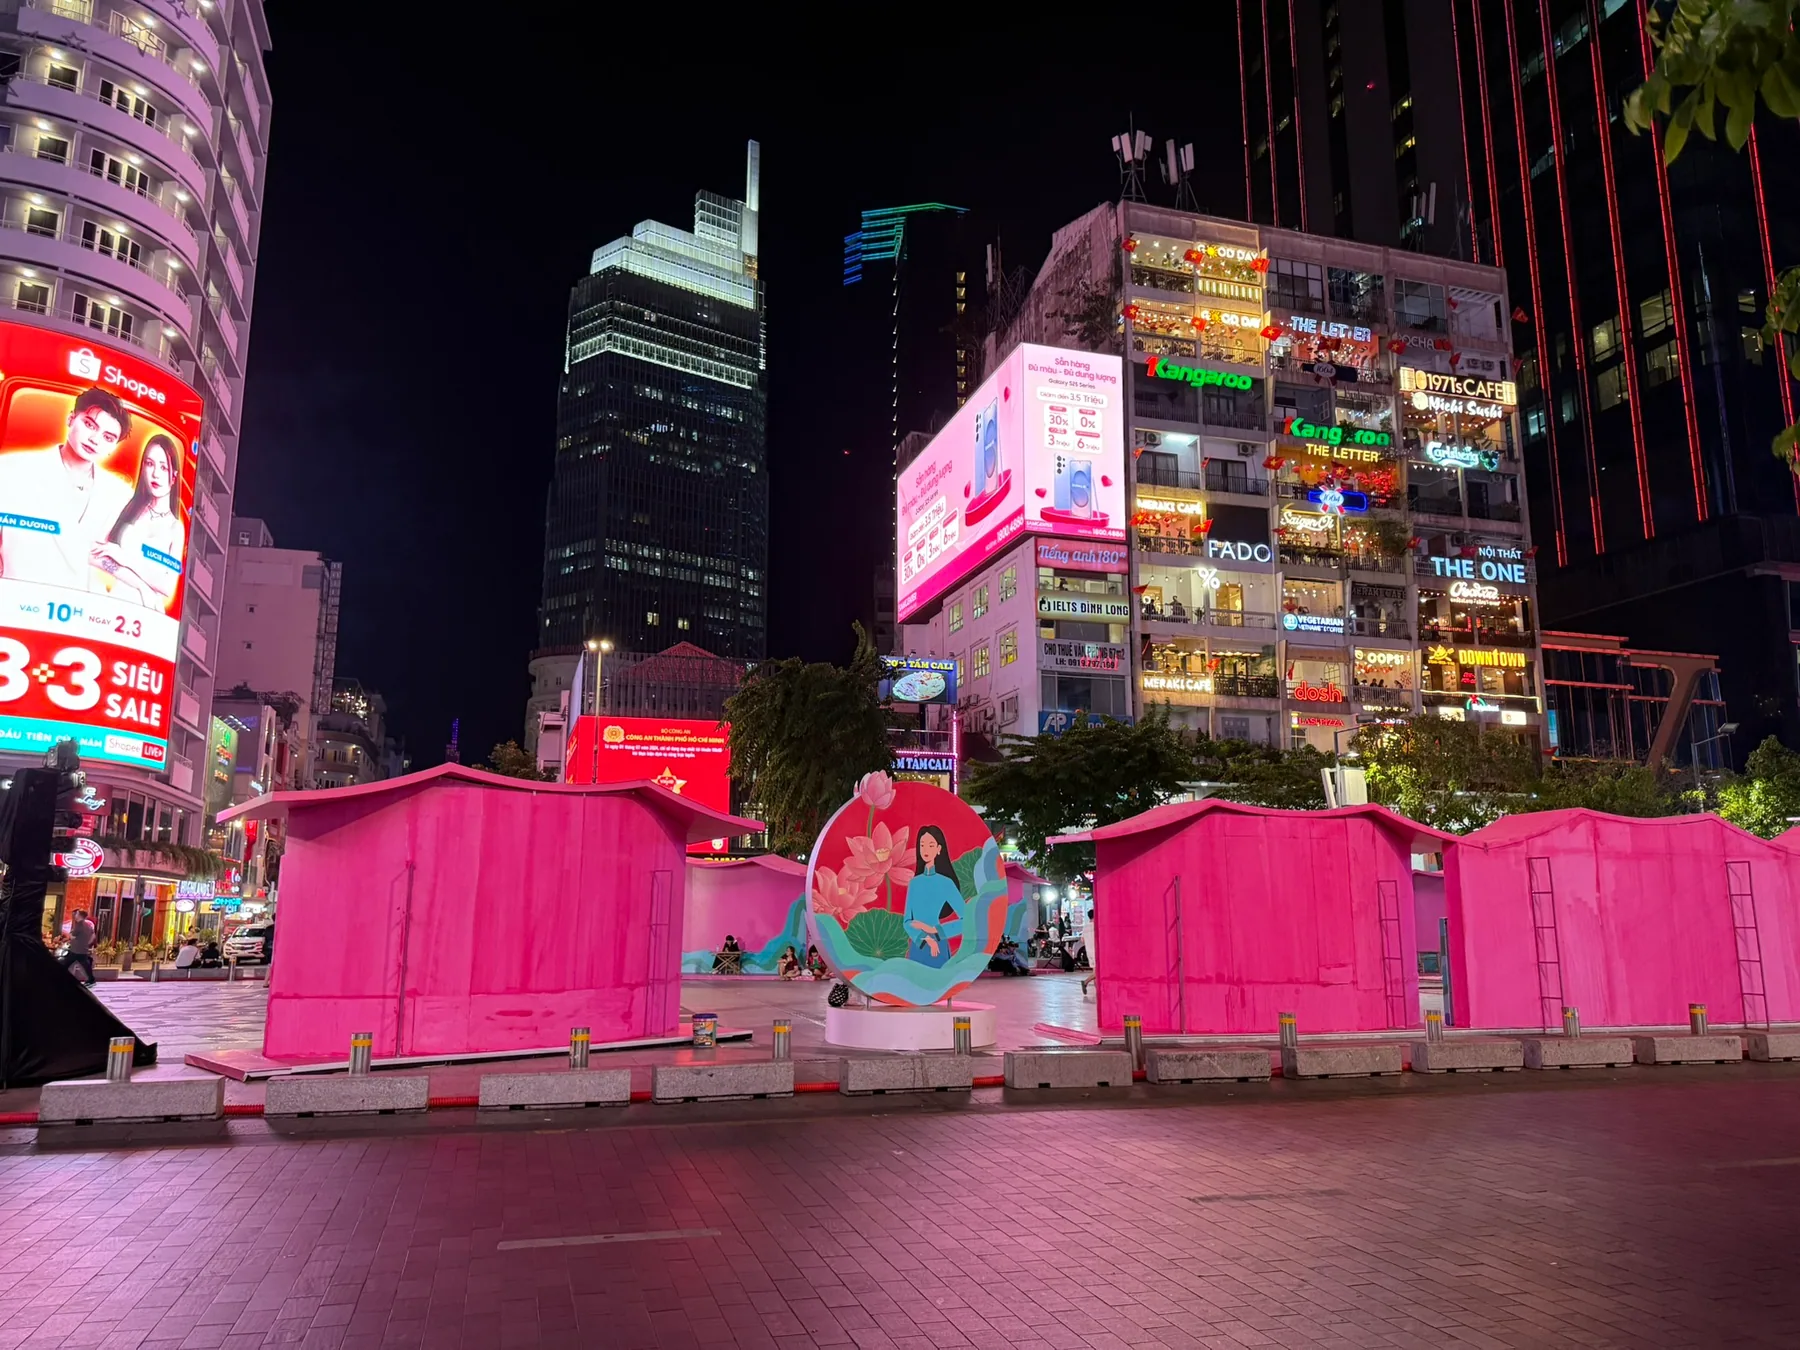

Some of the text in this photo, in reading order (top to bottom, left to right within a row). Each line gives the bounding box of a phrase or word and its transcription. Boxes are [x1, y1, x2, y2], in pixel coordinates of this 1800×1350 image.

[1236, 249, 1258, 261] DAY
[1291, 316, 1317, 333] THE
[1145, 355, 1252, 390] Kangaroo
[103, 364, 166, 404] Shopee
[1070, 392, 1081, 401] 3.5
[1466, 401, 1503, 418] Sushi
[1049, 414, 1069, 426] 30%
[1080, 416, 1096, 429] 0%
[1048, 434, 1055, 445] 3
[1283, 416, 1390, 446] Kangroo
[1077, 437, 1085, 449] 6
[1306, 443, 1379, 463] THE LETTER
[1038, 544, 1069, 564] Tiếng
[1208, 539, 1272, 562] FADO
[1479, 545, 1522, 559] NỘI THẤT
[1431, 556, 1526, 583] THE ONE
[1053, 600, 1129, 616] IELTS ĐÌNH LONG
[114, 615, 142, 637] 2.3
[1044, 643, 1056, 656] CHO
[1058, 642, 1073, 657] THUÊ
[931, 662, 954, 670] CALI
[47, 647, 102, 711] 3
[111, 661, 163, 695] SIÊU
[1144, 677, 1185, 689] MERAKI
[1294, 680, 1342, 703] dosh
[104, 693, 162, 727] SALE
[109, 738, 160, 758] Shopee LIVE
[928, 758, 952, 770] CALI
